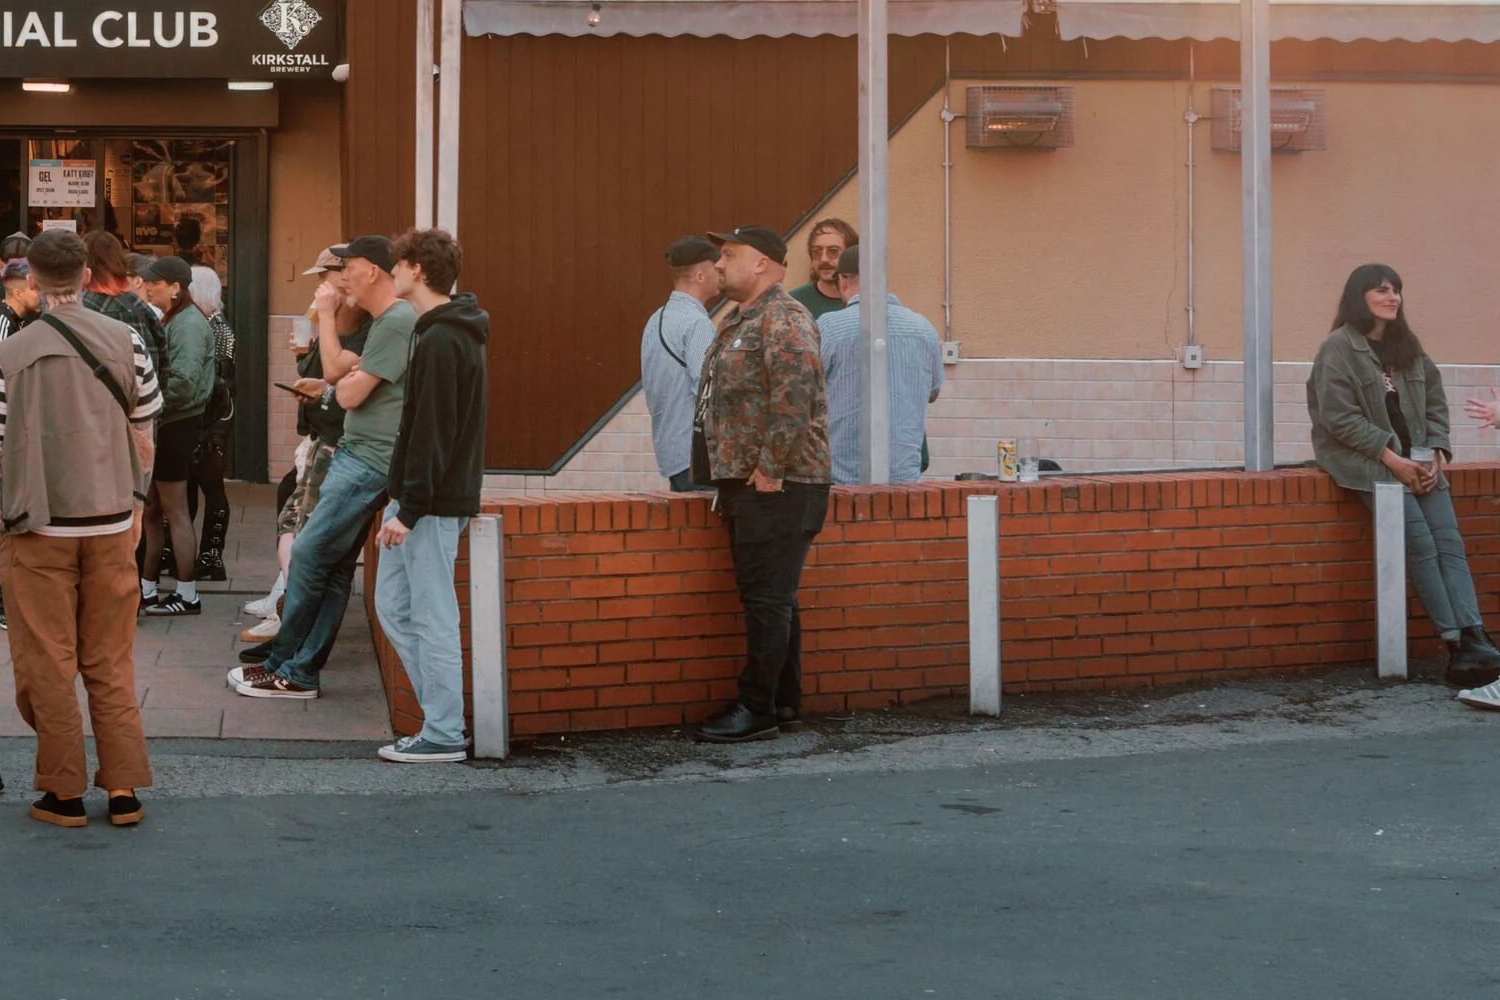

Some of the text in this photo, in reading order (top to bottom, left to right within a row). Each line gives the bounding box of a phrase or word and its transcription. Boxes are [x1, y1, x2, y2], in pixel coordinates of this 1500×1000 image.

[92, 10, 219, 48] CLUB
[251, 54, 329, 65] KIRKSTALL
[38, 171, 52, 182] GEL
[63, 170, 78, 178] KATY
